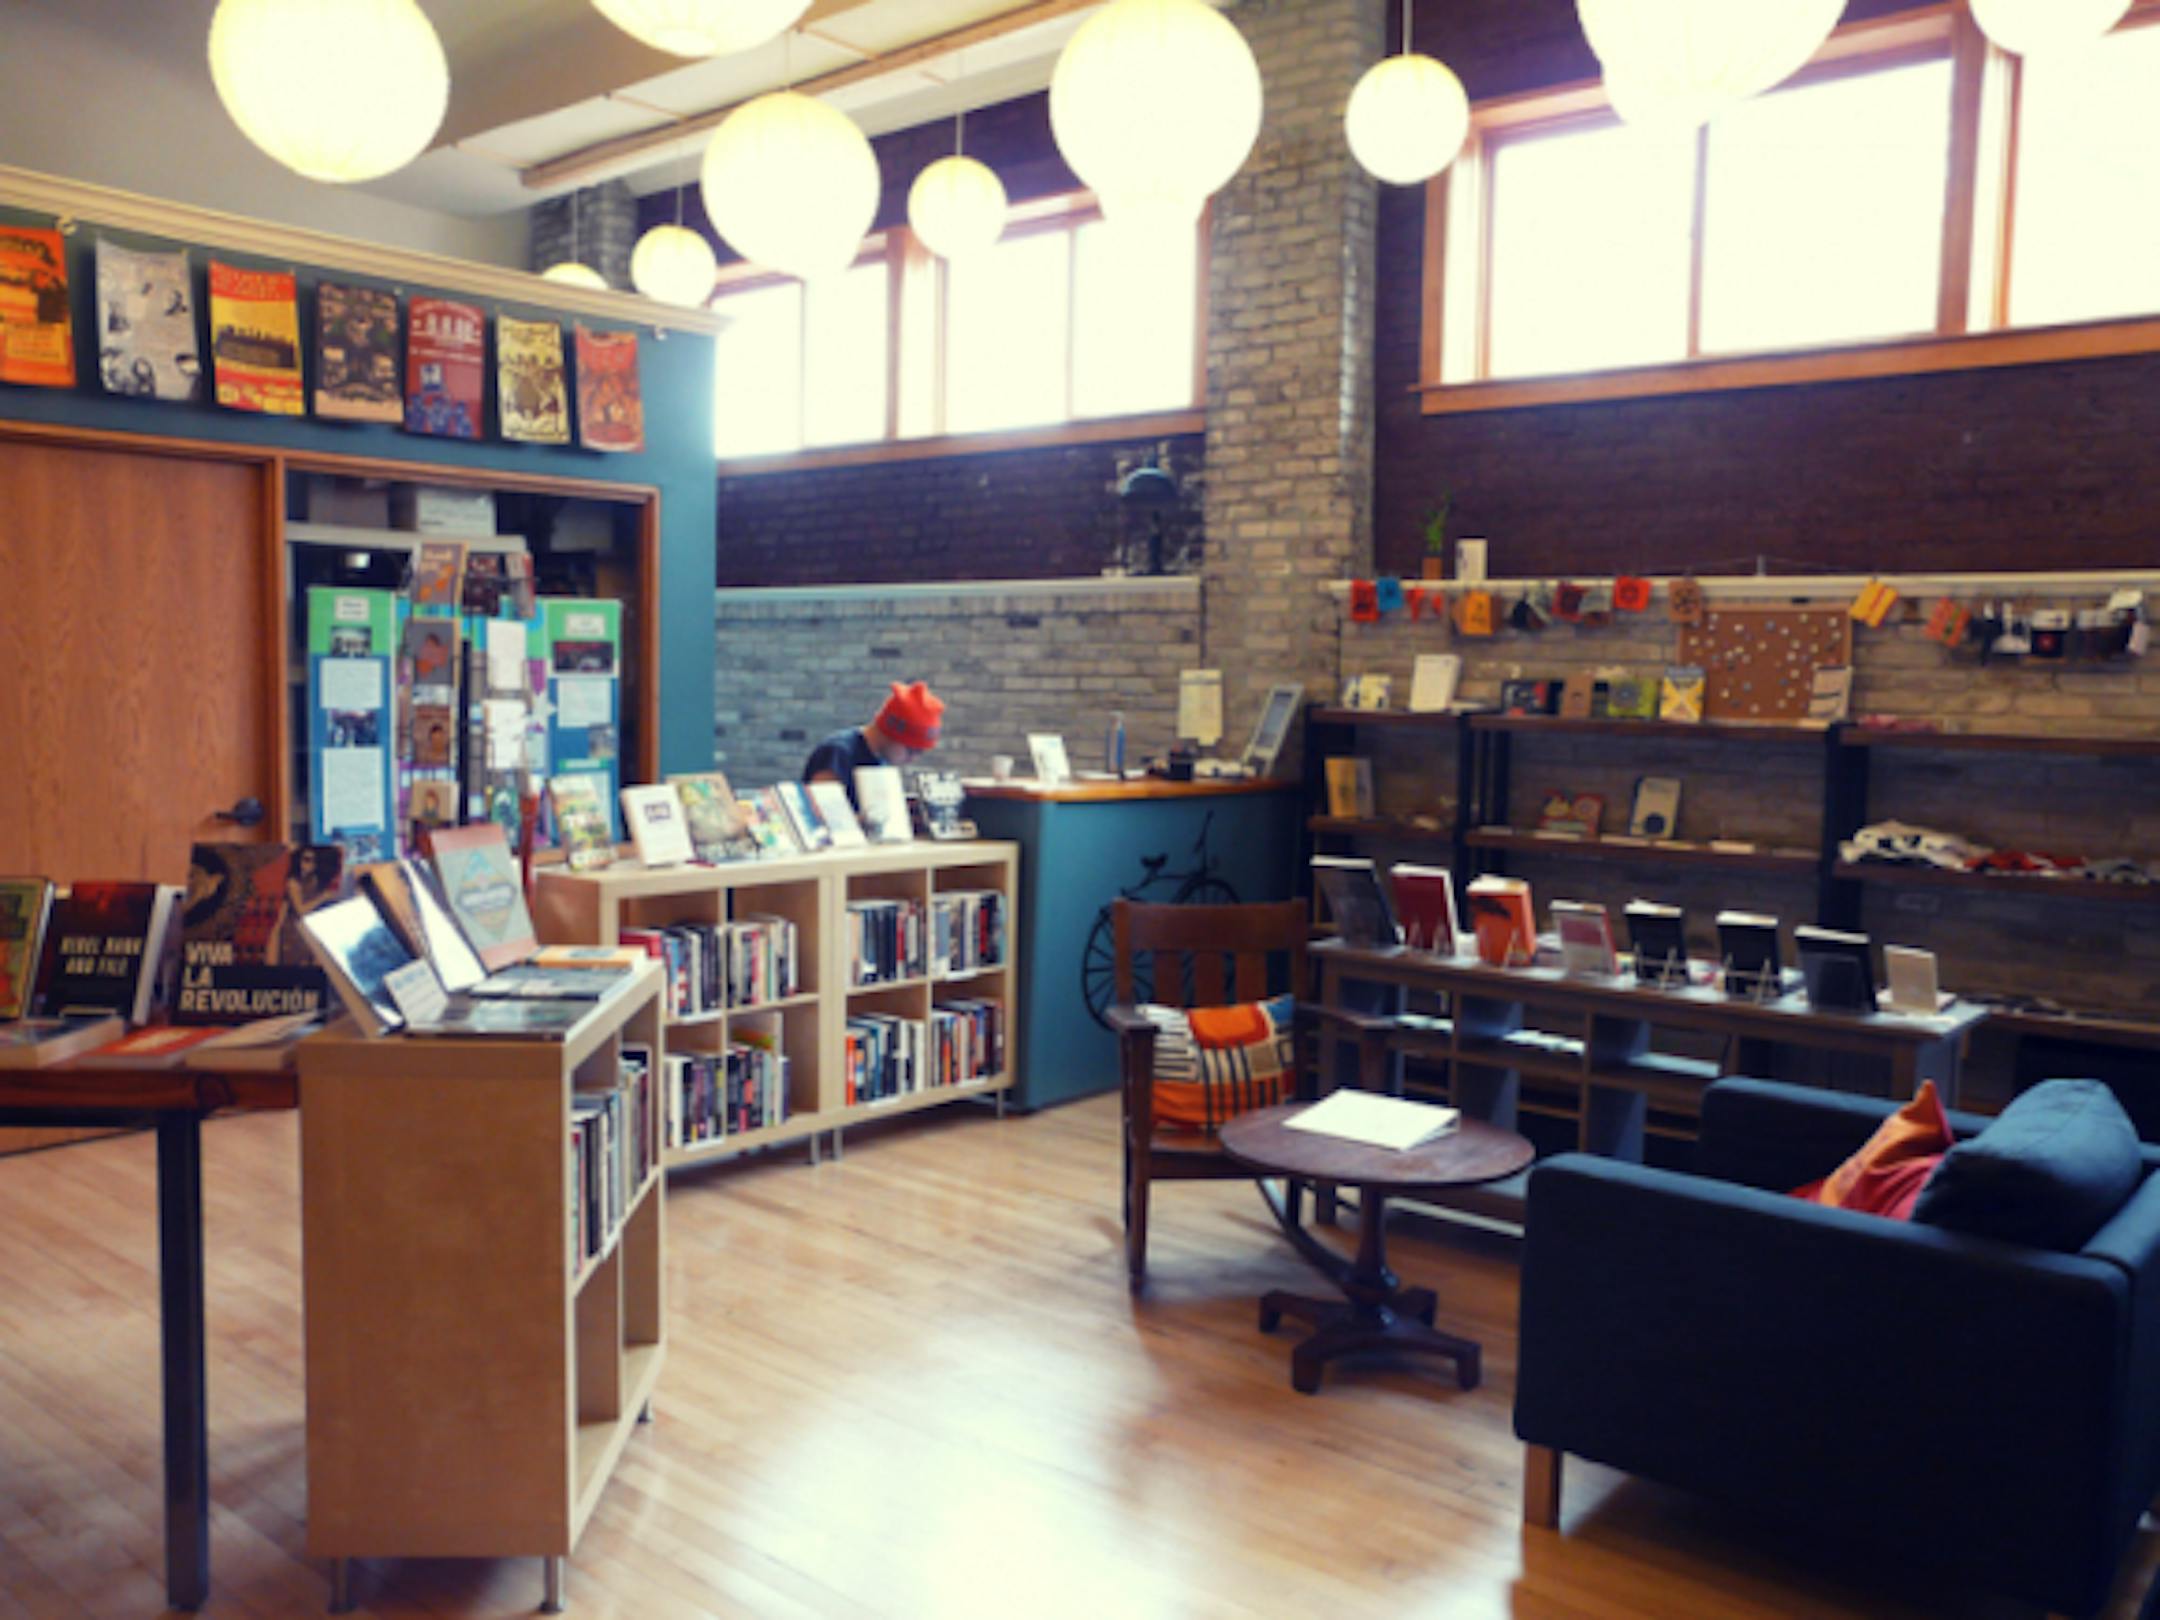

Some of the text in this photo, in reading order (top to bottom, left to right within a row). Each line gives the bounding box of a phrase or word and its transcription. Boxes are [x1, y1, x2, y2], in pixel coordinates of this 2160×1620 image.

[183, 942, 233, 965] VIVA
[183, 967, 214, 988] LA
[179, 986, 320, 1014] REVOLUCIÓN
